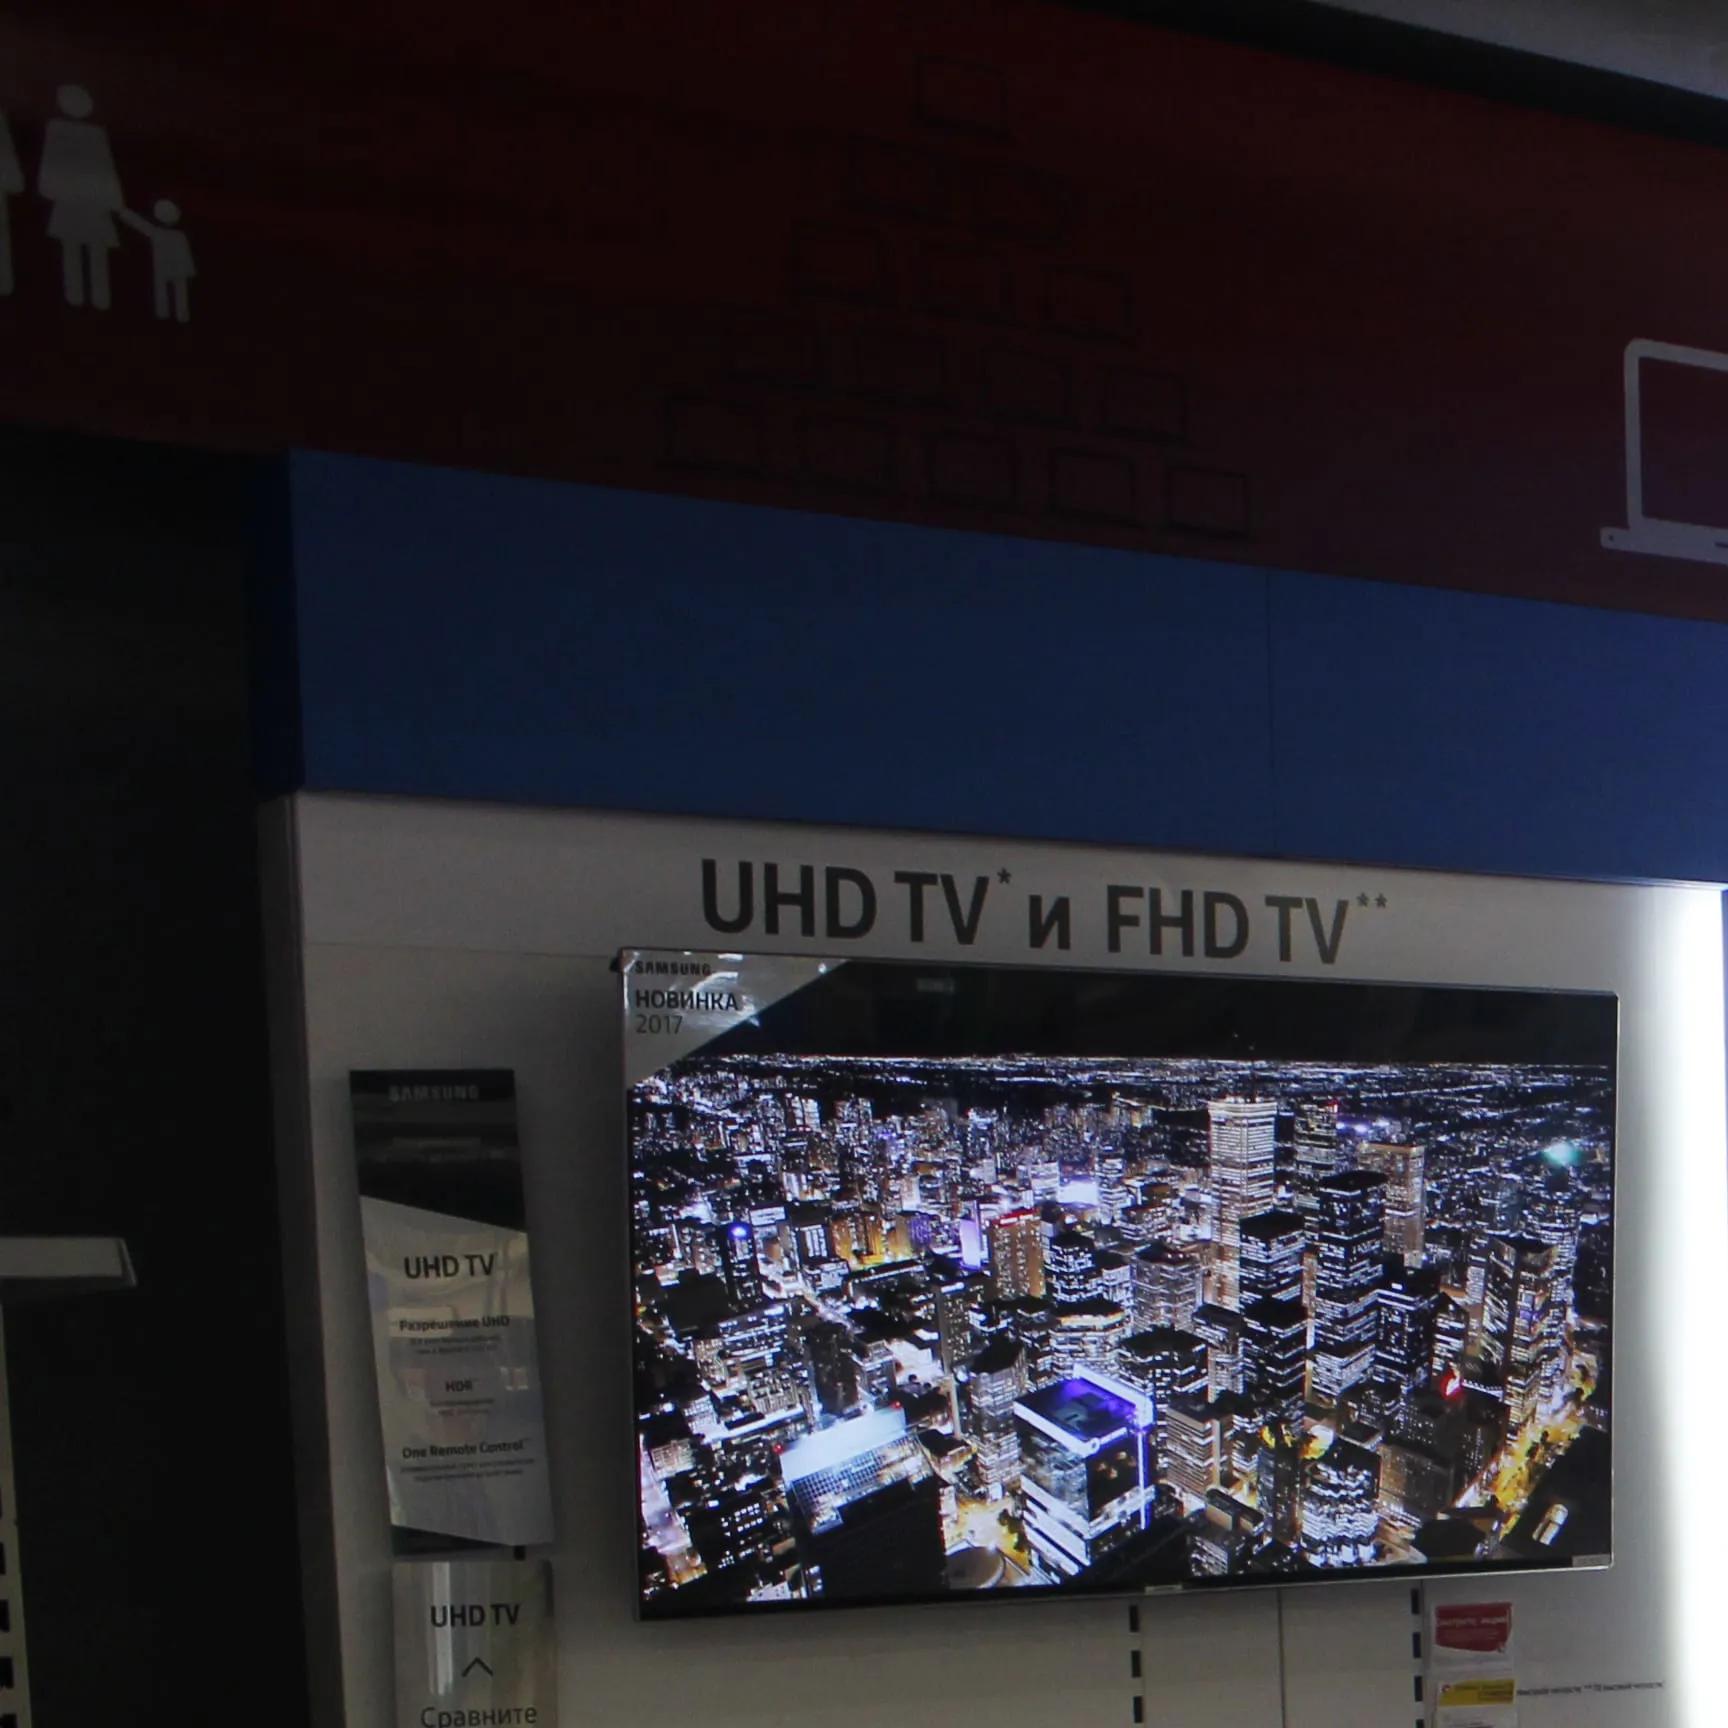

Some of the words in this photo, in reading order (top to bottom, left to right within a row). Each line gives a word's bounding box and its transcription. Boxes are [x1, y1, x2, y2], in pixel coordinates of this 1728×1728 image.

[701, 858, 877, 940] UHD
[1029, 895, 1071, 951] и
[1107, 885, 1250, 960] FHD
[635, 960, 711, 976] SAMSUNG
[635, 989, 739, 1011] НОВИНКА
[636, 1014, 683, 1035] 2017
[404, 1256, 459, 1280] UHD
[465, 1253, 496, 1277] TV
[445, 1380, 474, 1393] HDR
[402, 1446, 428, 1459] One
[429, 1443, 478, 1457] Remote
[430, 1605, 486, 1629] UHD
[490, 1604, 522, 1626] TV
